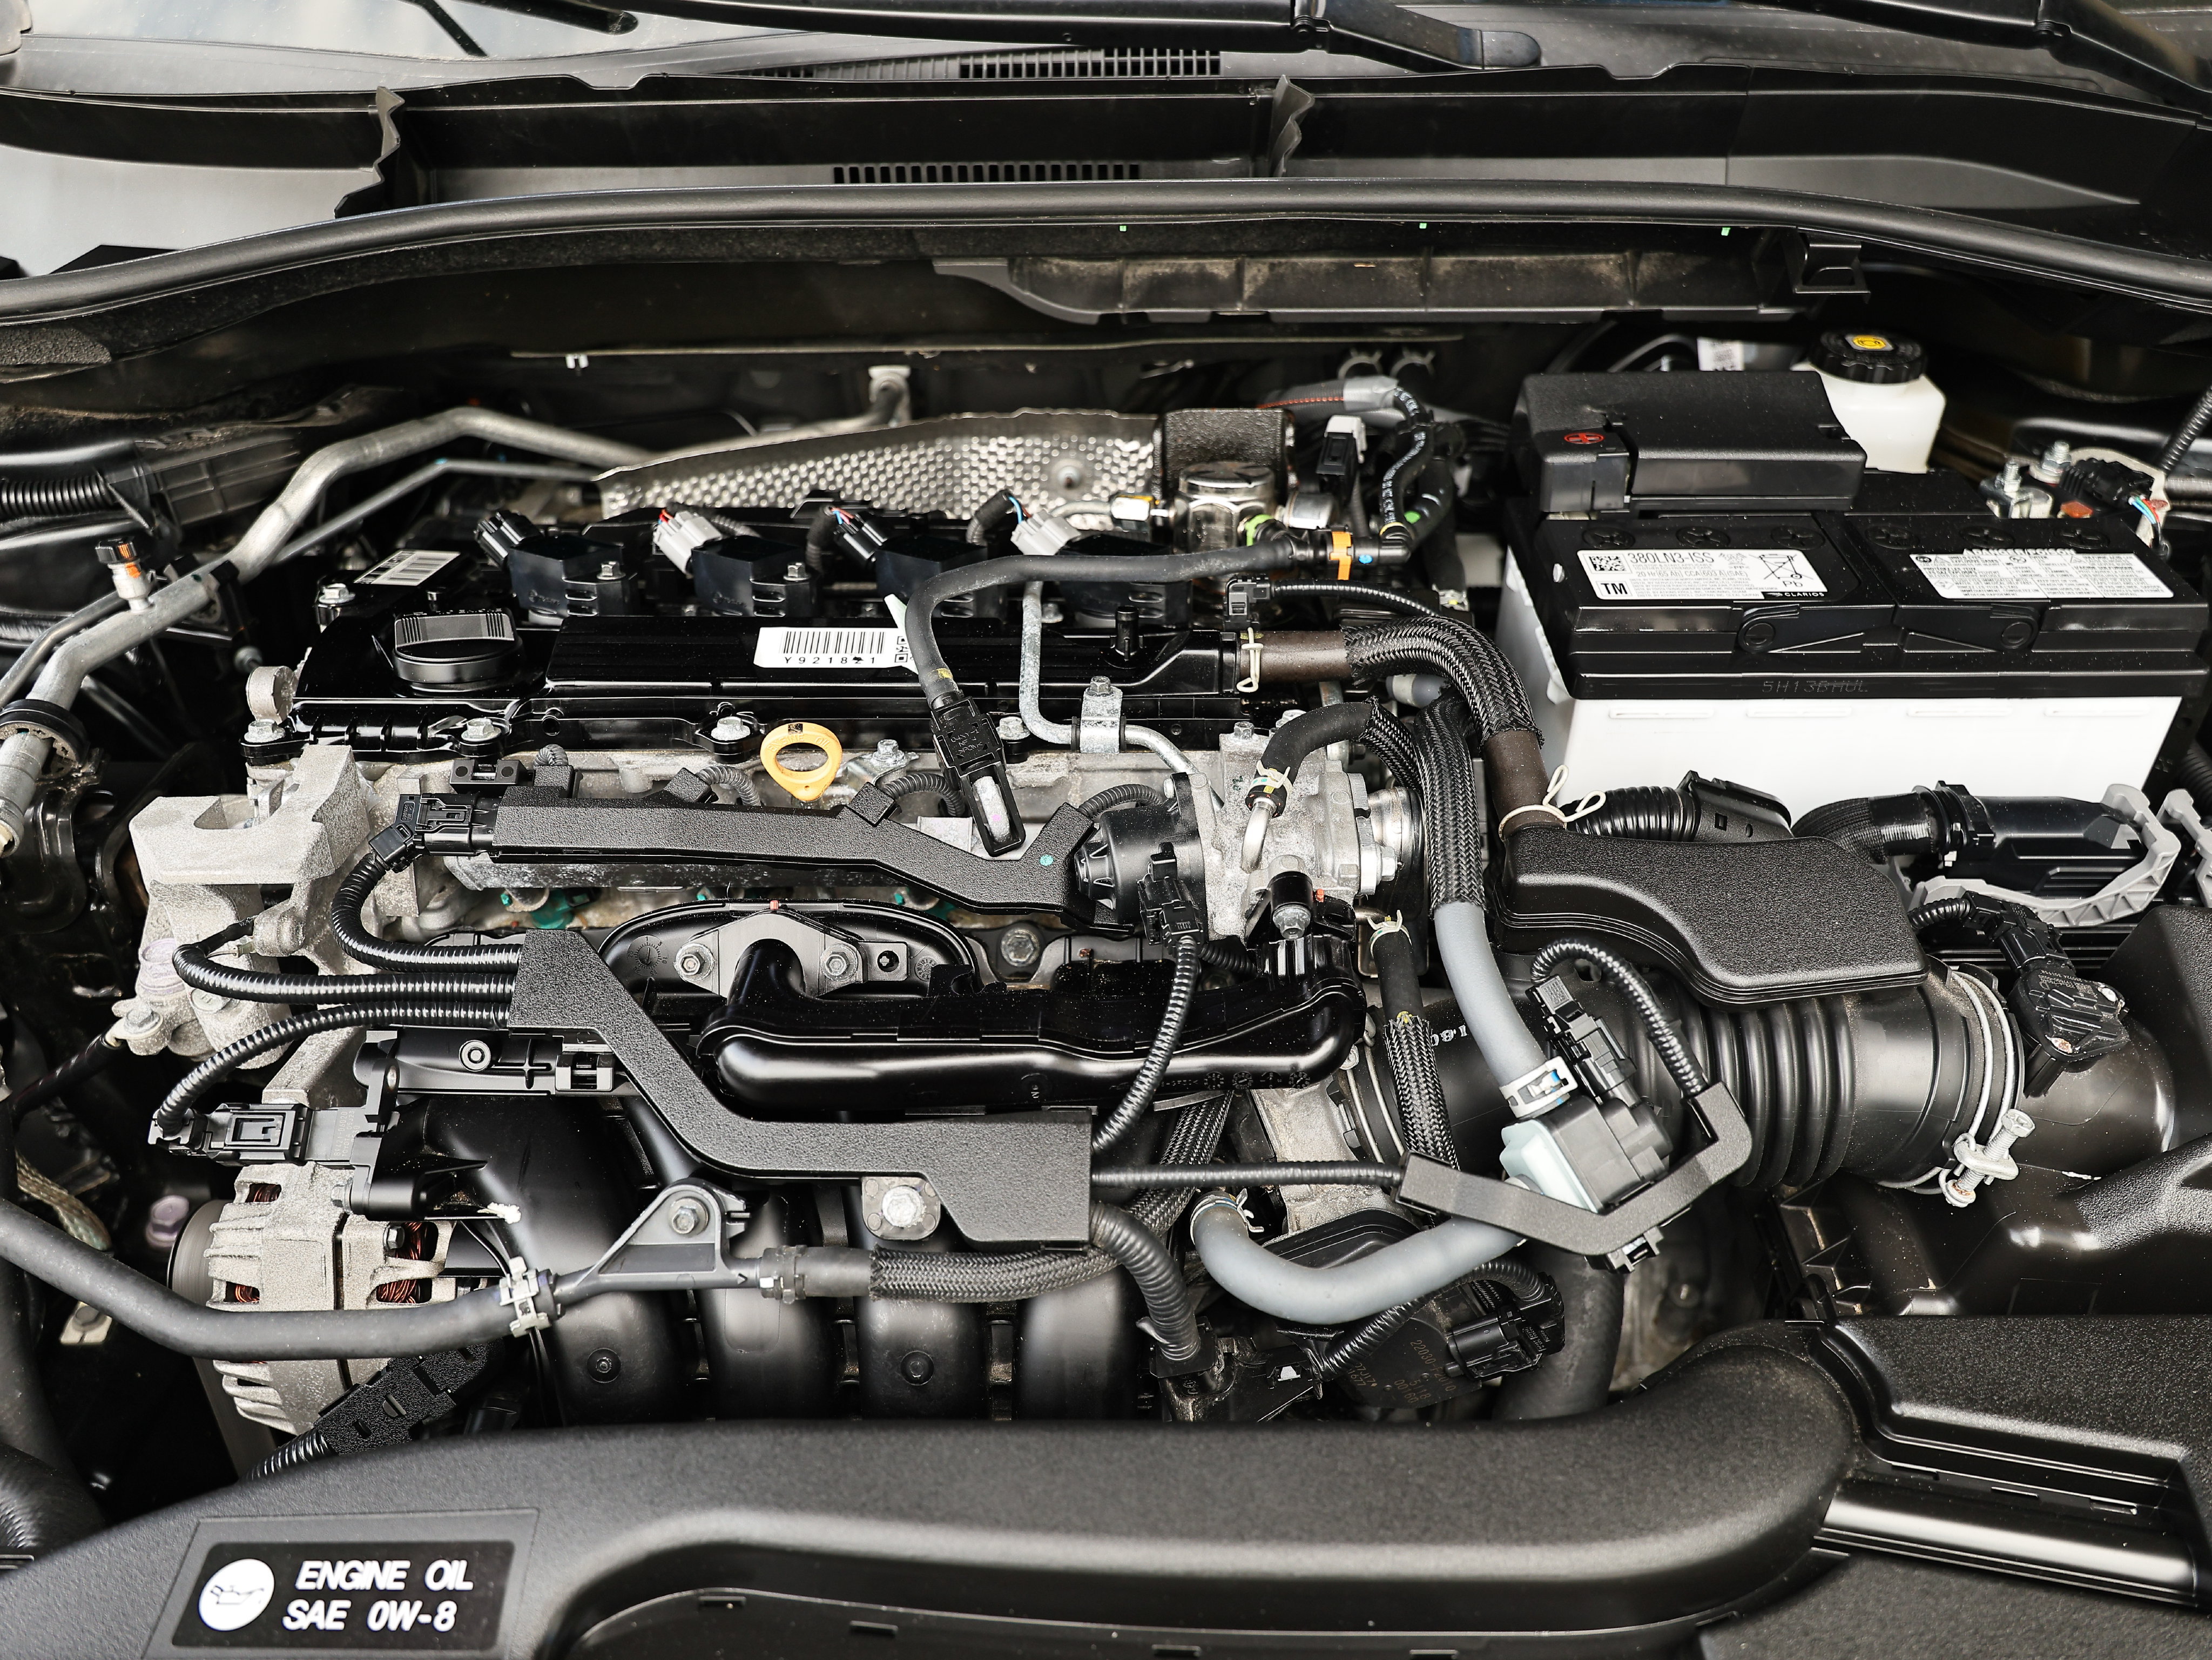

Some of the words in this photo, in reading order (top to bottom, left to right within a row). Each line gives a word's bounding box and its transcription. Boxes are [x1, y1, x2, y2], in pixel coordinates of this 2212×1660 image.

[1627, 552, 1715, 563] 380LN3-ISS
[1601, 583, 1628, 595] TM
[767, 733, 805, 752] ENGINE
[814, 737, 830, 750] OIL
[295, 1560, 410, 1591] ENGINE
[424, 1559, 474, 1591] OIL
[282, 1599, 351, 1631] SAE
[367, 1600, 458, 1632] 0W-8
